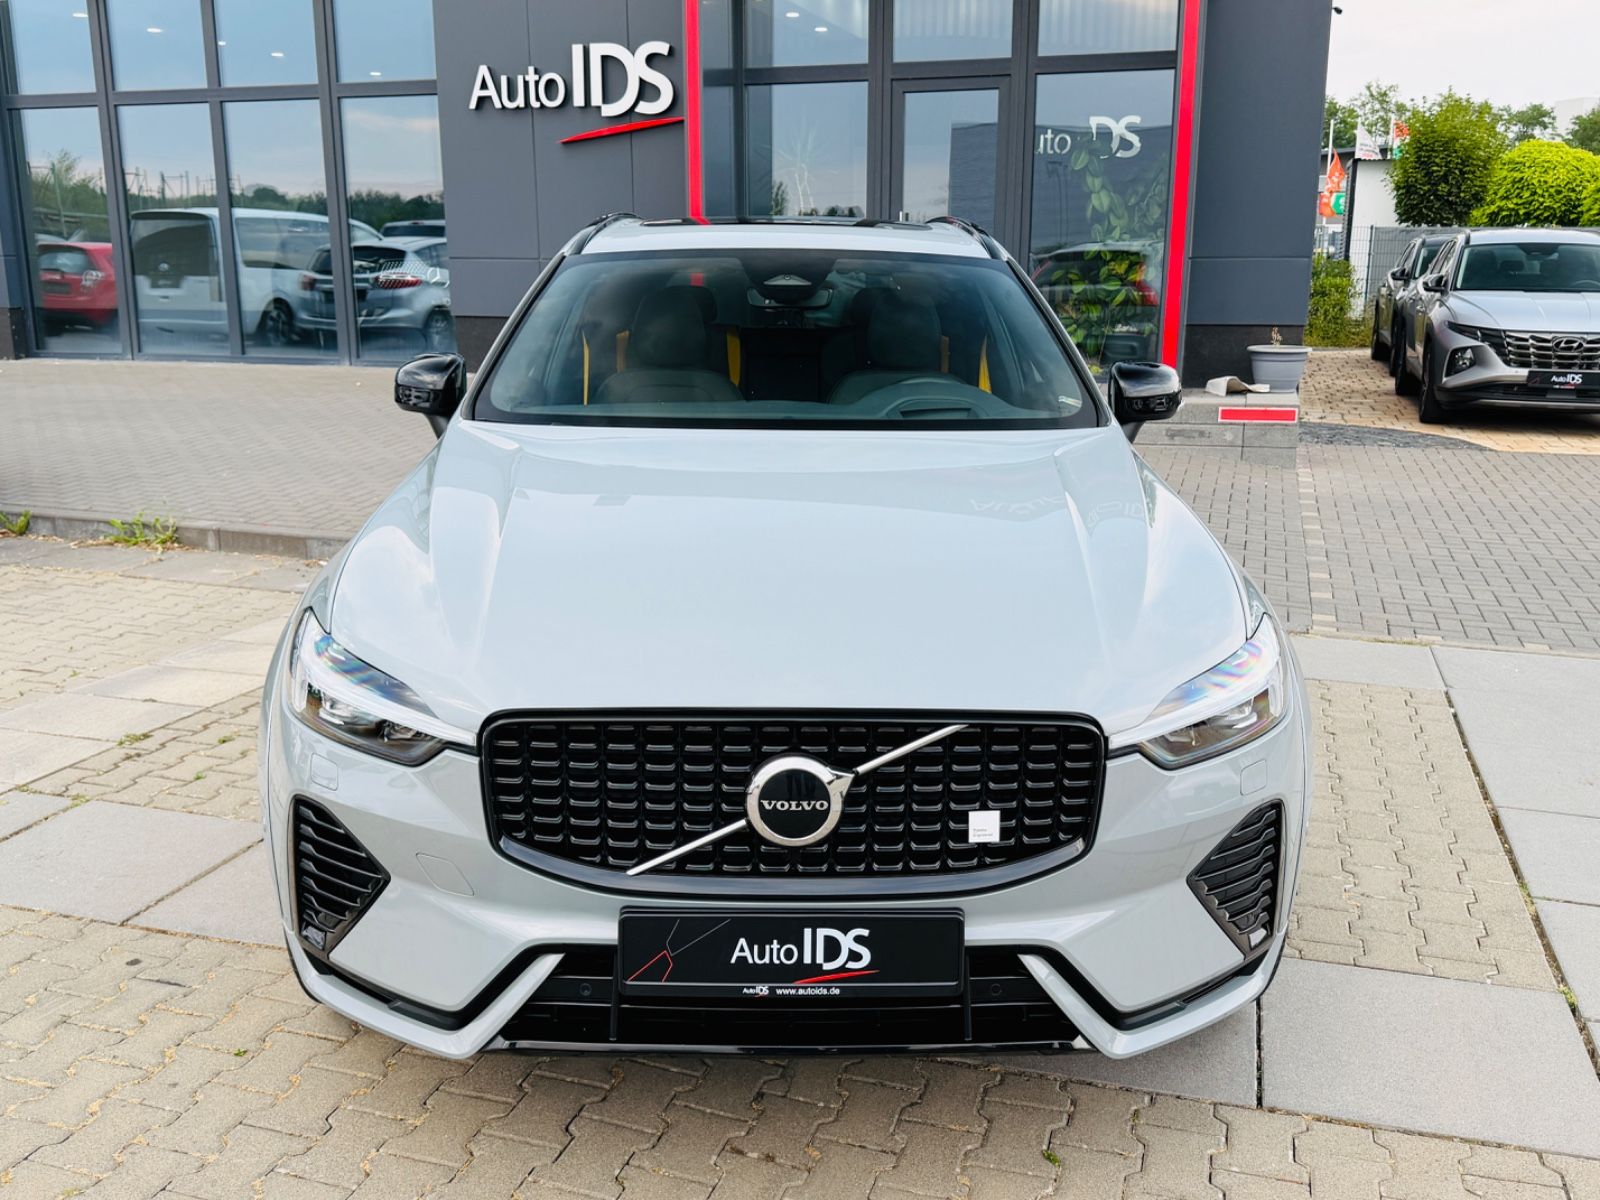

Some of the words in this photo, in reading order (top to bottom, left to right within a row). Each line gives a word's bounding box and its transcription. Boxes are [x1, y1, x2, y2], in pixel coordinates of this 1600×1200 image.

[469, 64, 566, 109] Auto
[571, 41, 674, 117] IDS
[760, 800, 829, 811] VOLVO
[730, 937, 798, 965] Auto
[803, 928, 871, 971] IDS
[776, 987, 840, 996] www.autoids.de
